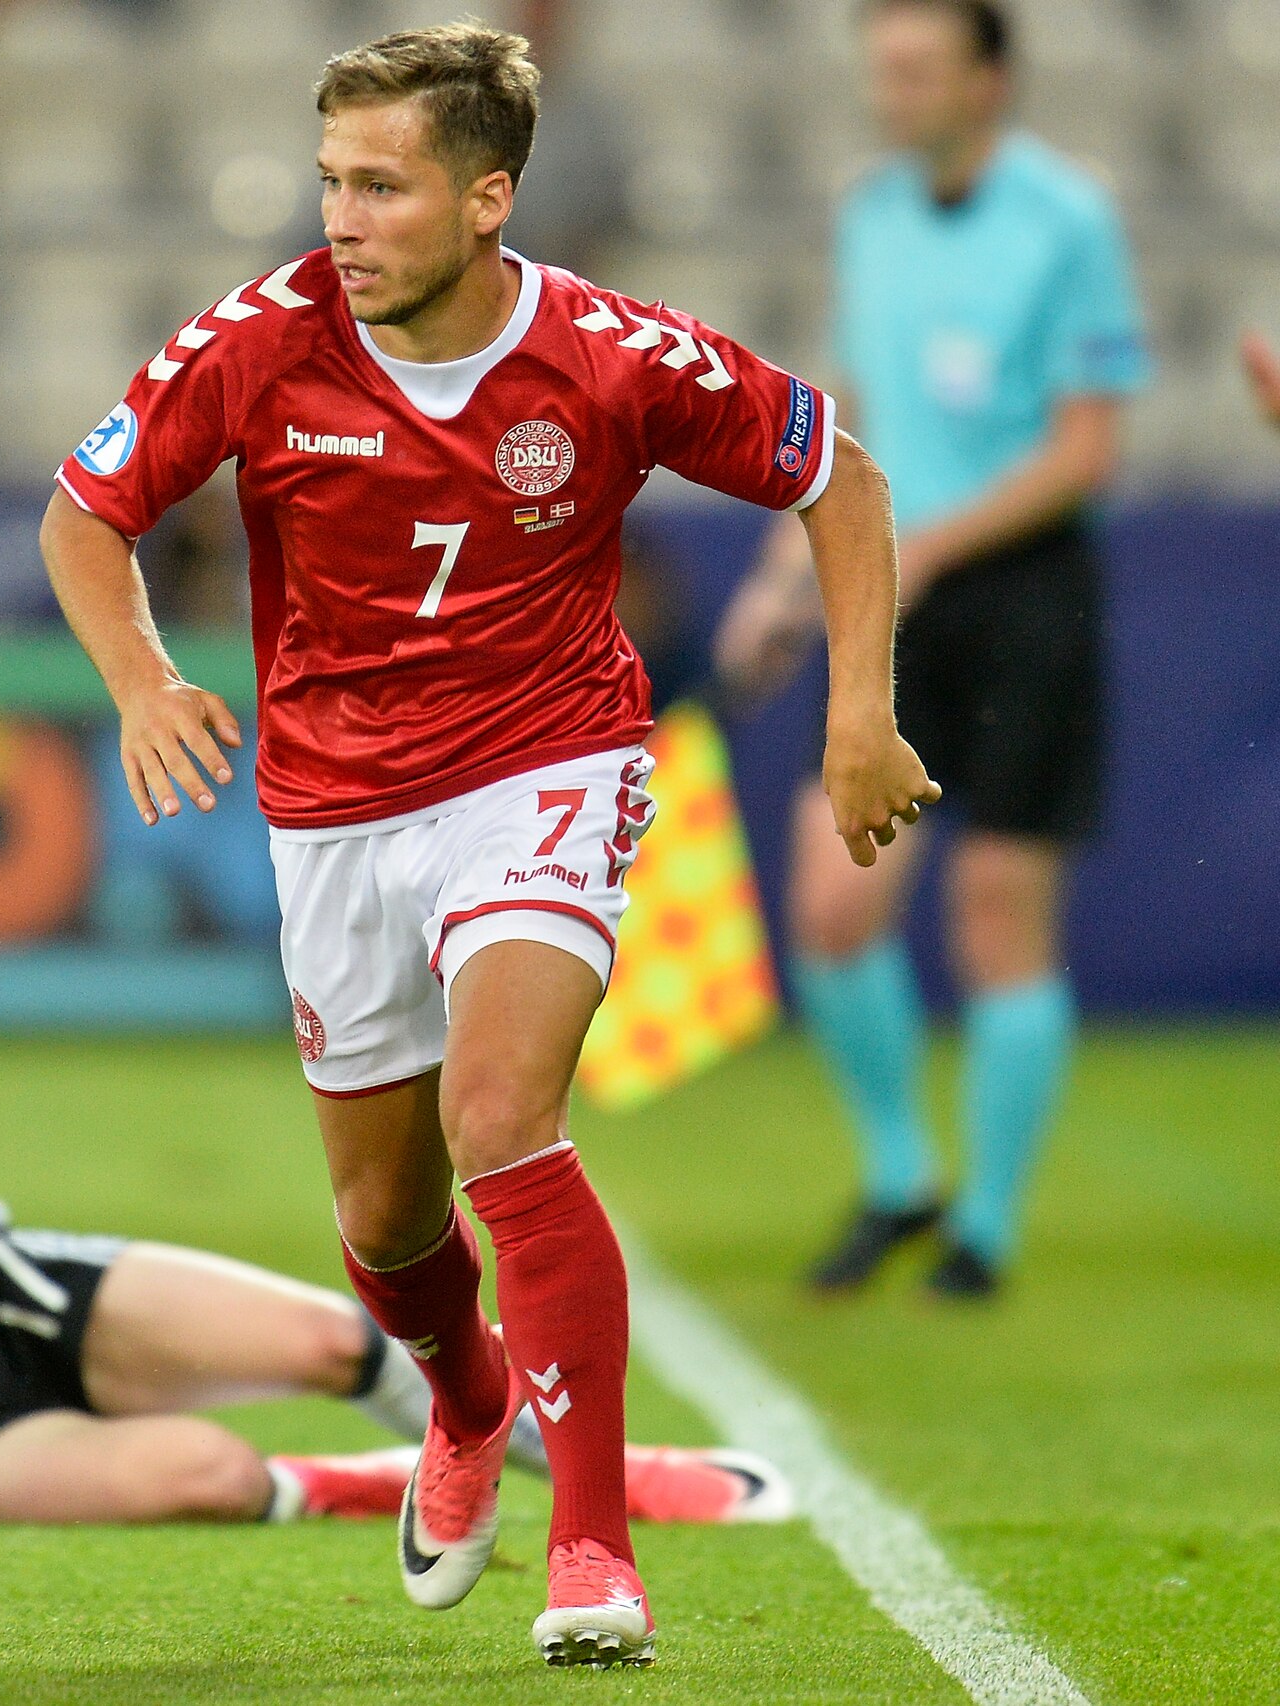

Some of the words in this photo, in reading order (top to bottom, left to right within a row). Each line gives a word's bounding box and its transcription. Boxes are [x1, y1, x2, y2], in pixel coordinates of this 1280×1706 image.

[790, 380, 809, 447] RESPECT
[286, 424, 385, 458] hummel
[511, 444, 559, 468] DBU
[520, 481, 552, 494] 1889
[410, 520, 471, 620] 7
[533, 786, 588, 857] 7
[503, 863, 589, 892] hummel
